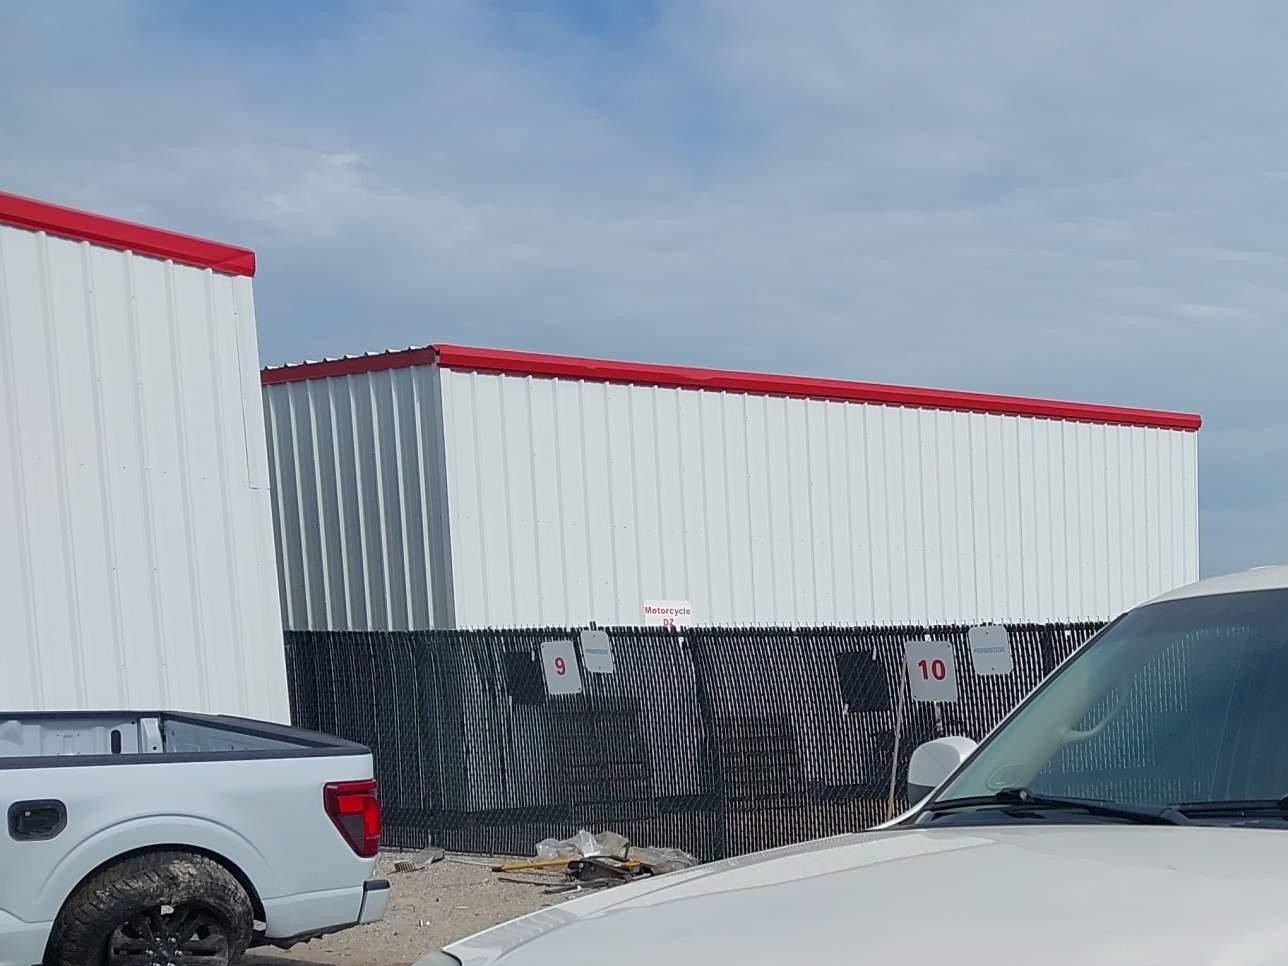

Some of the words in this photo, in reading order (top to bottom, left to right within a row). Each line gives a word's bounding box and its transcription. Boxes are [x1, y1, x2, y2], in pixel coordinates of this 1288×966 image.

[644, 606, 692, 617] Motorcycle
[555, 657, 566, 676] 9
[918, 660, 946, 681] 10
